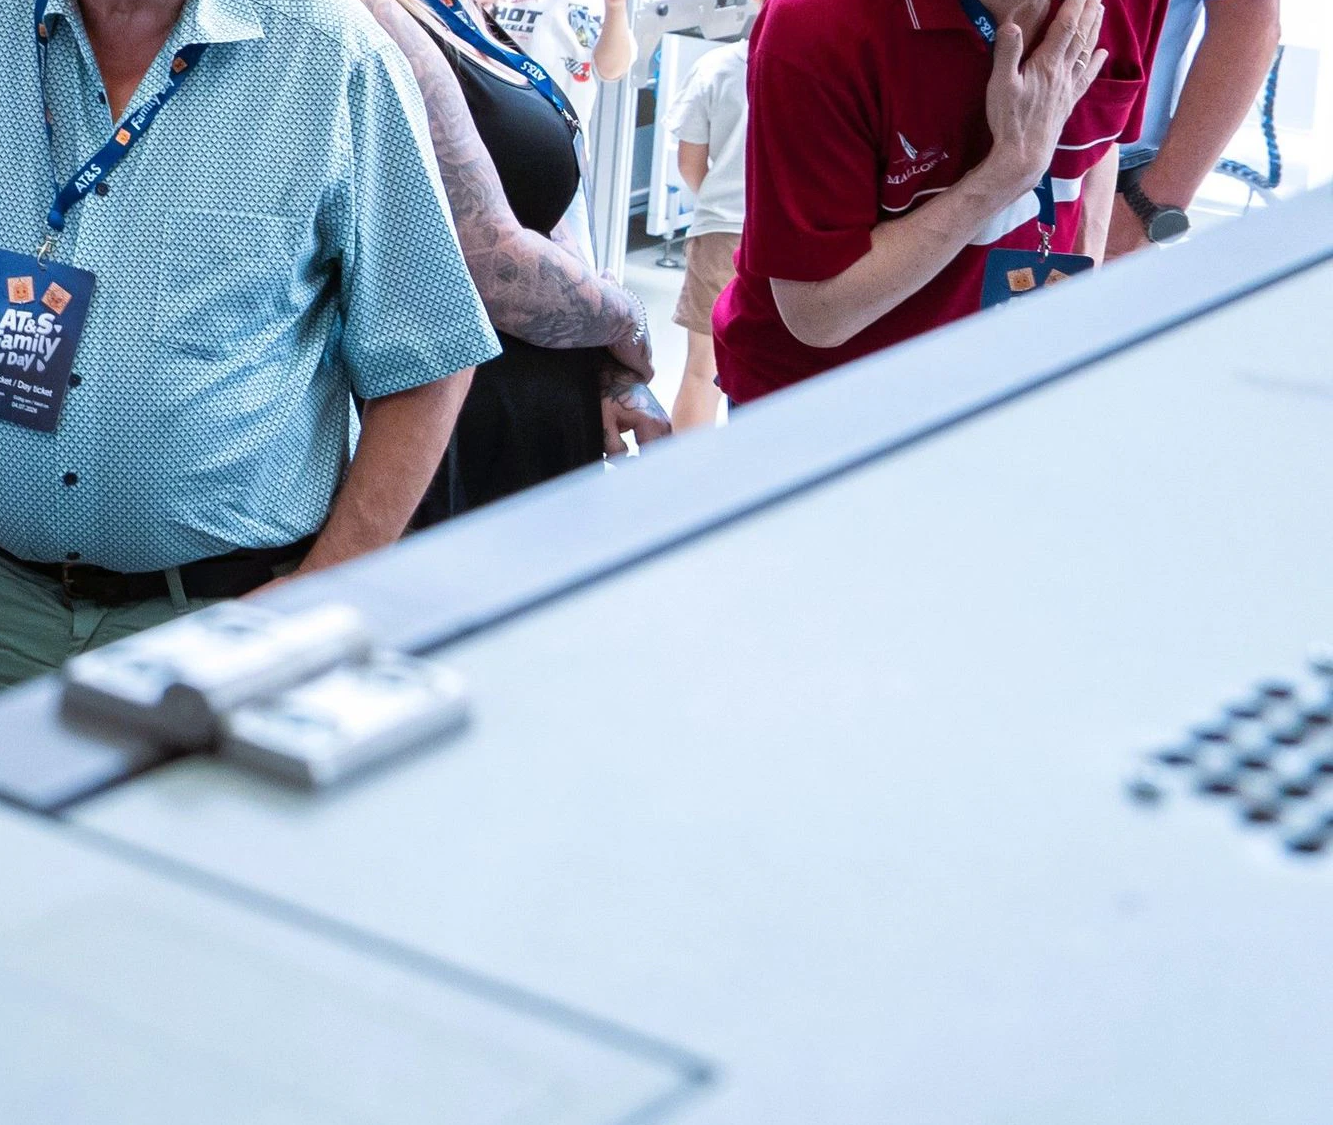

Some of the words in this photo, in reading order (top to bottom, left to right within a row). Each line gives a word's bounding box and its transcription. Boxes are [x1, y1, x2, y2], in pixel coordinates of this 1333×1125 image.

[520, 61, 547, 82] AT&S
[130, 94, 161, 131] Family
[74, 163, 102, 193] AT&S
[886, 151, 949, 184] MALLOA
[6, 351, 36, 372] Day
[17, 380, 32, 393] Day
[32, 385, 53, 397] ticket
